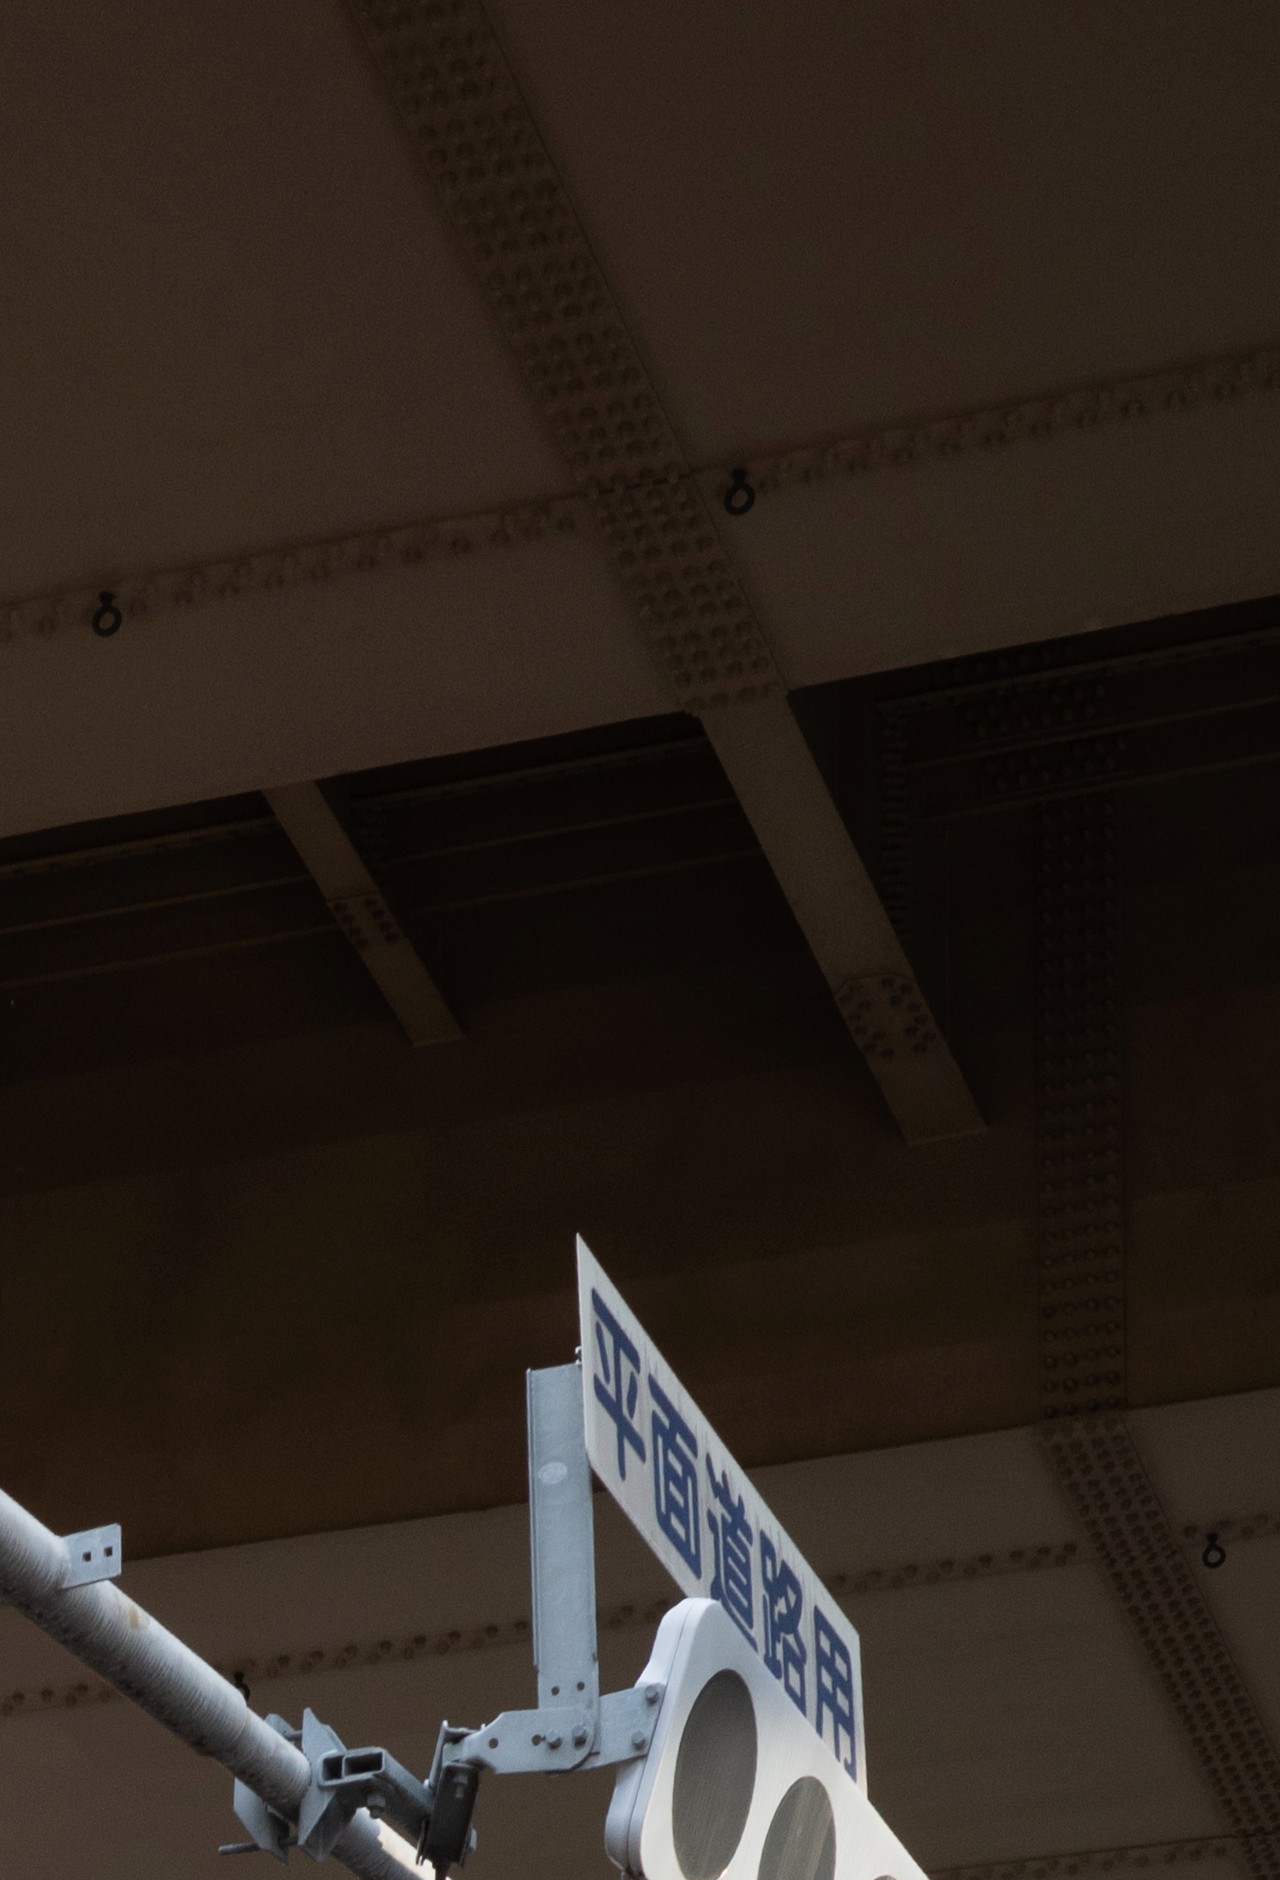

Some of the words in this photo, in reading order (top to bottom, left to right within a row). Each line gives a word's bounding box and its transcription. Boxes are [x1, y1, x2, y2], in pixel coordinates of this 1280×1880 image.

[592, 1287, 858, 1784] 平面道路用
